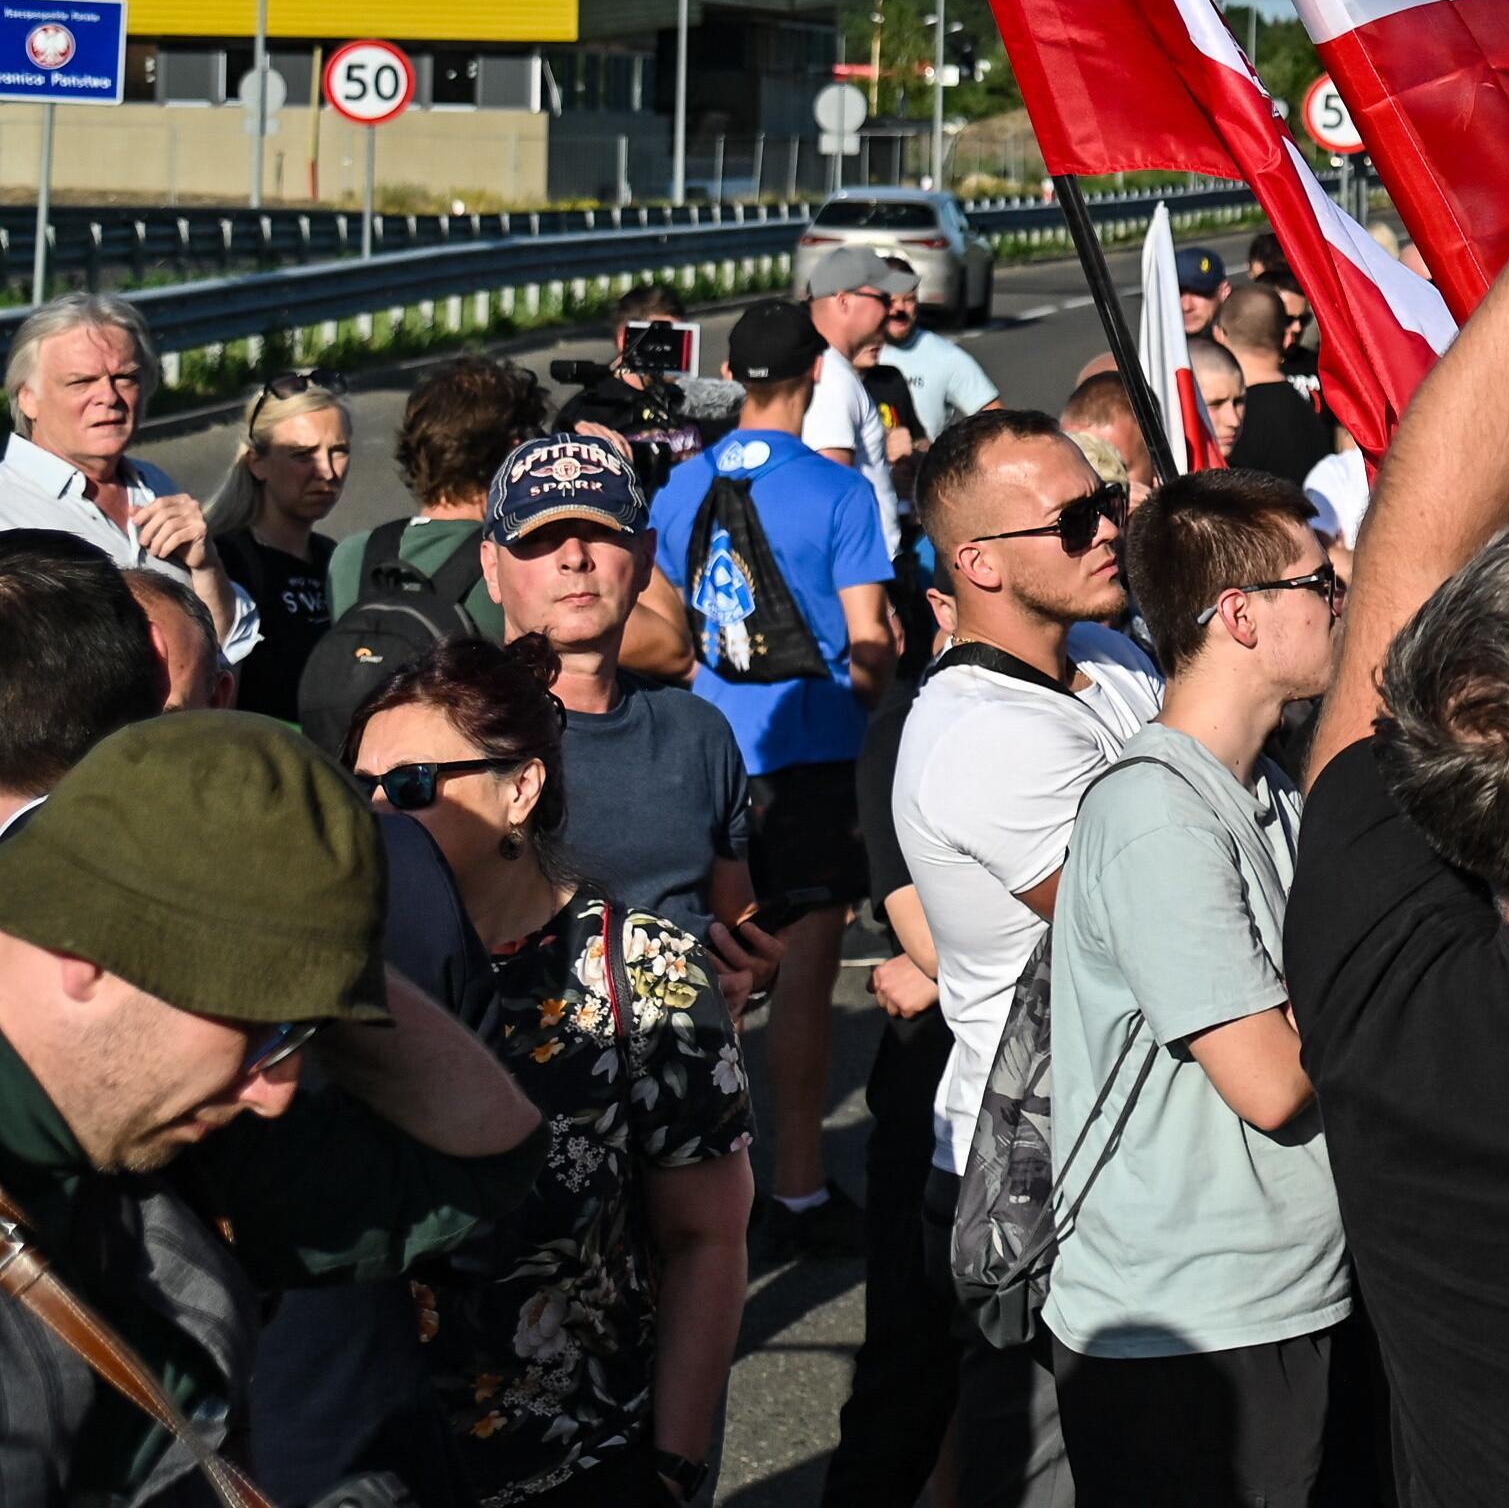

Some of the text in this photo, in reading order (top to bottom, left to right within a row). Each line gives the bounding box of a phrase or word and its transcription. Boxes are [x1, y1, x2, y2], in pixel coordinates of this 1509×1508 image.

[0, 73, 46, 86] ranica
[345, 64, 399, 101] 50
[1322, 94, 1343, 129] 5
[511, 442, 622, 483] SPITFIRE
[530, 480, 604, 497] SPARK
